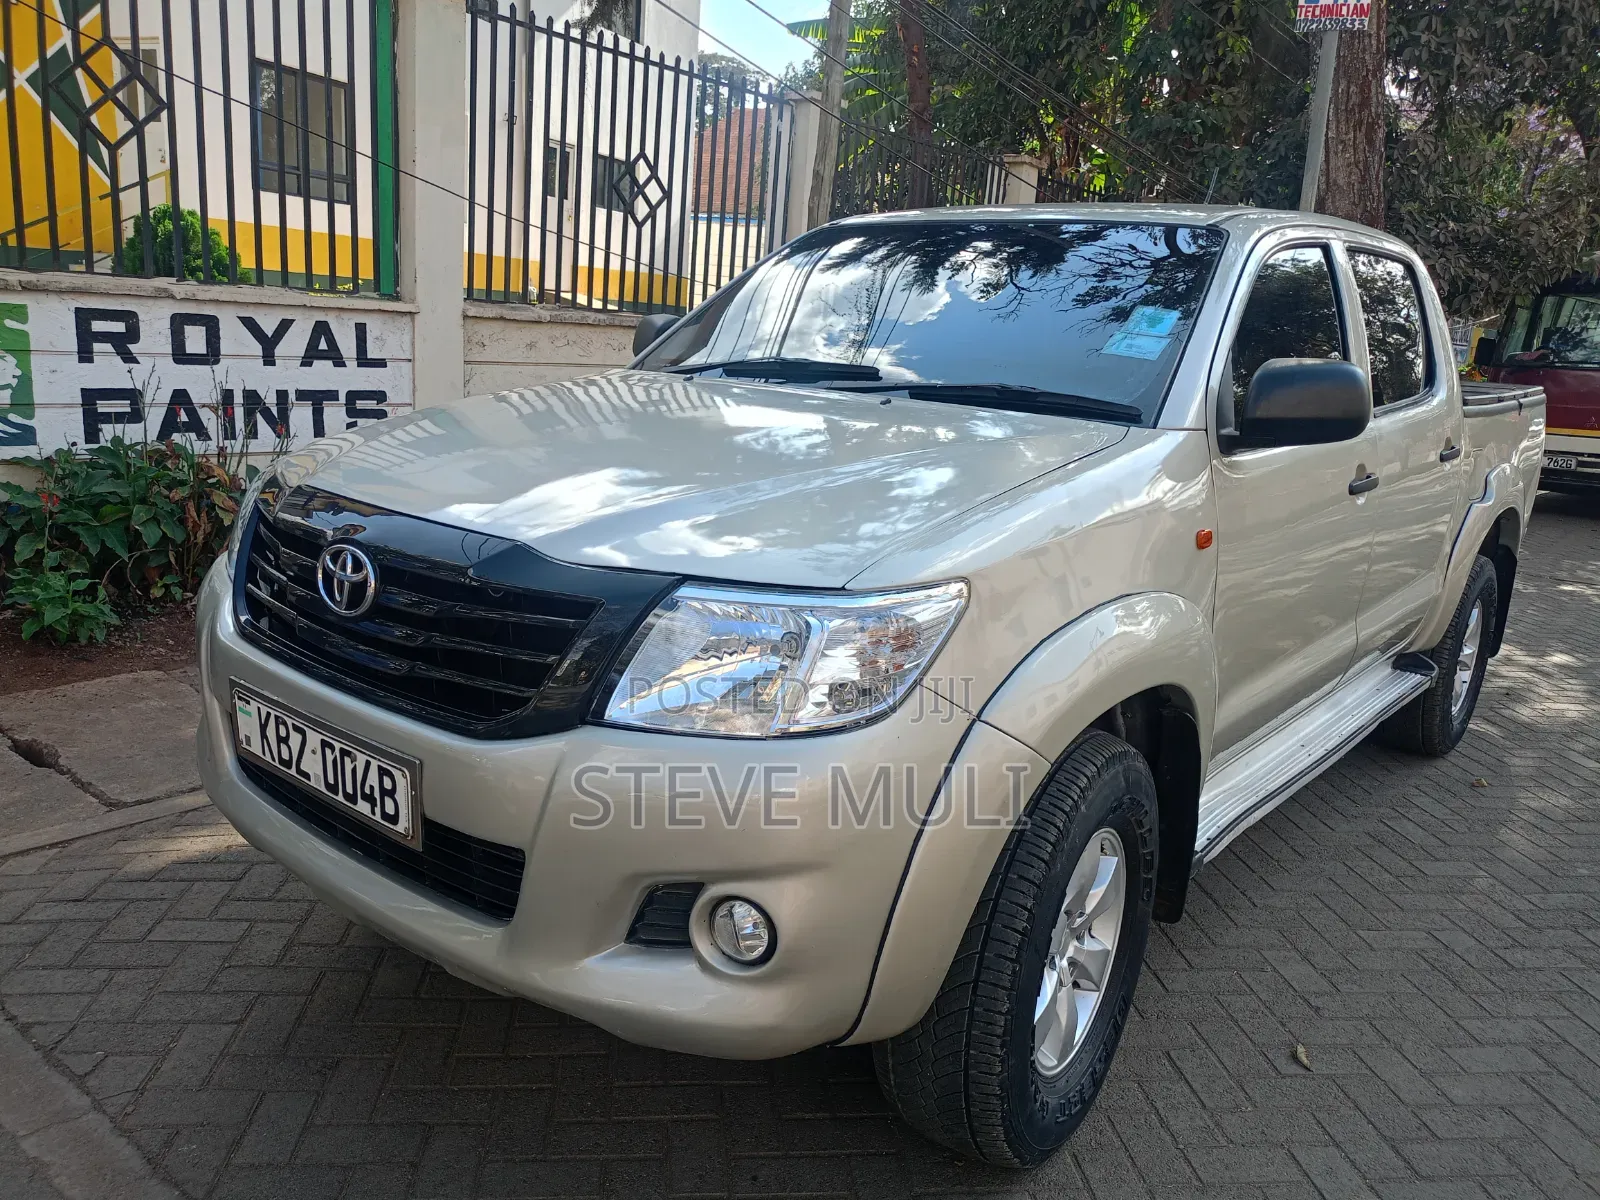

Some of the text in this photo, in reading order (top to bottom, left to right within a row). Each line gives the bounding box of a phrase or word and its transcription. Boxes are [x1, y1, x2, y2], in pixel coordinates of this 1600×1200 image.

[1297, 3, 1370, 18] TECHNICIAN
[75, 307, 388, 368] ROYAL
[80, 388, 389, 444] PAINTS
[257, 705, 400, 827] KBZ 004B
